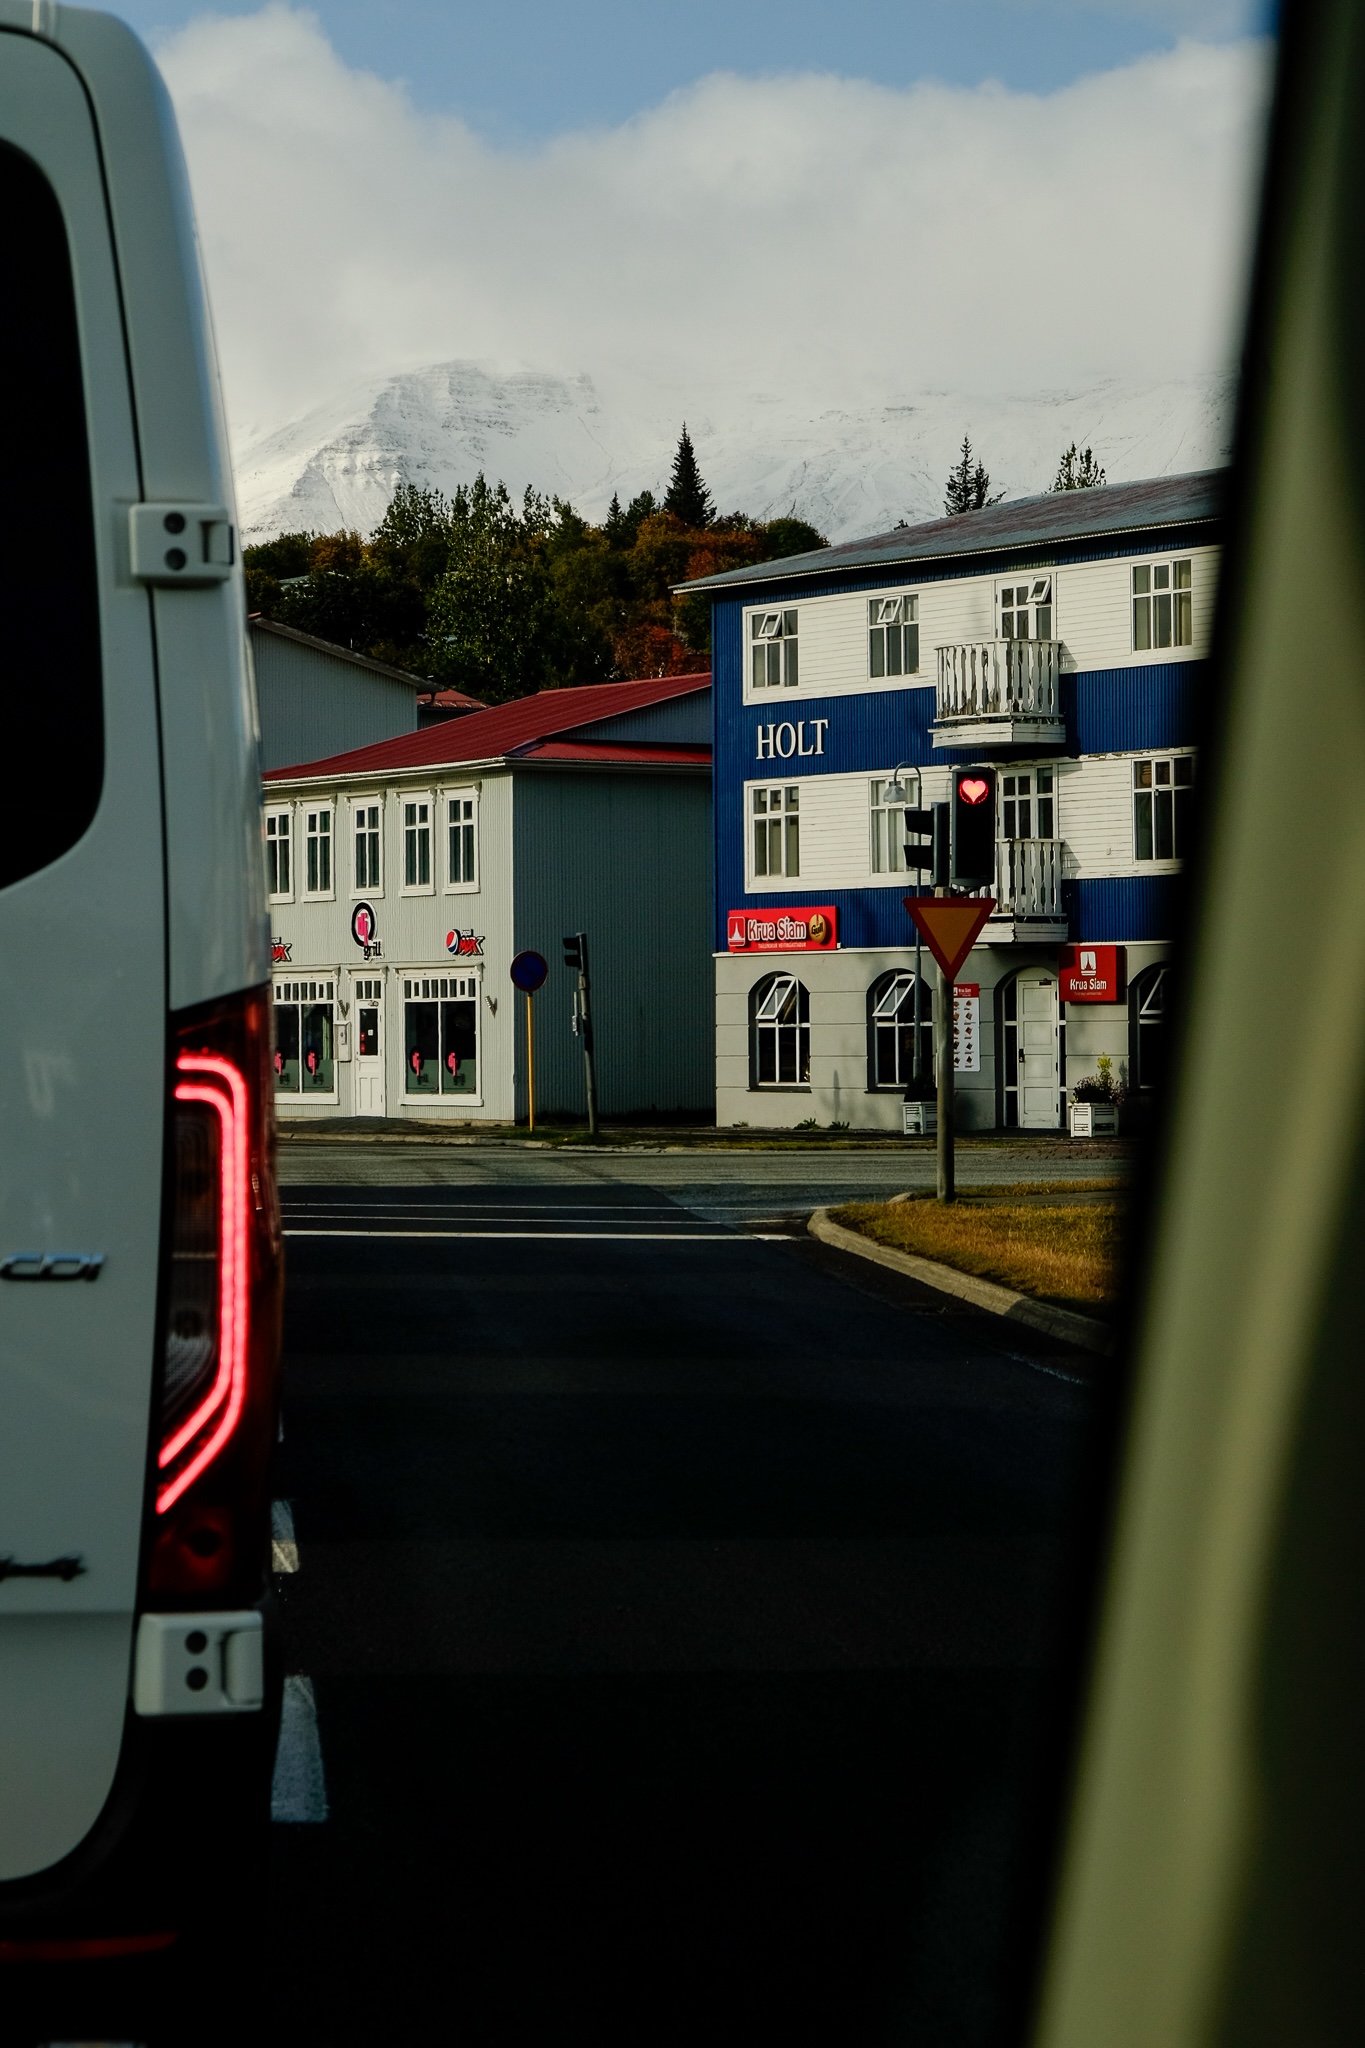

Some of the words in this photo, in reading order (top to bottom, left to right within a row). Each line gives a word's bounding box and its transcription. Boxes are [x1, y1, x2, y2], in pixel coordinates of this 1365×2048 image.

[756, 719, 829, 760] HOLT
[747, 919, 776, 941] Krua
[777, 916, 807, 941] Siam
[1070, 978, 1088, 991] Krua
[1089, 978, 1107, 990] Siam
